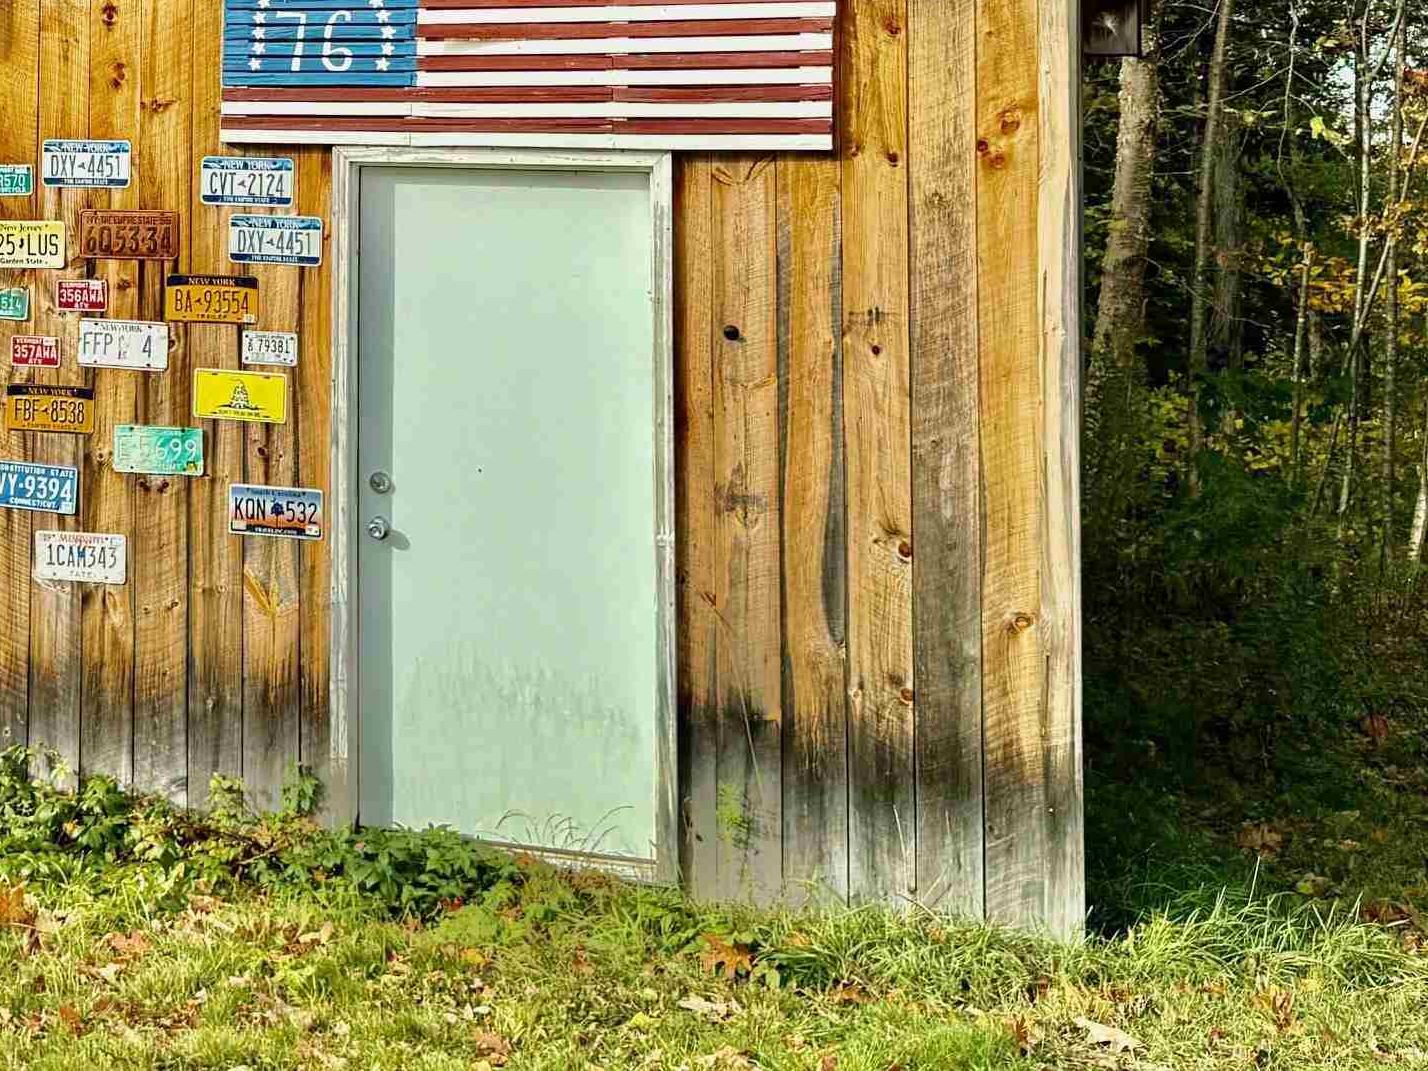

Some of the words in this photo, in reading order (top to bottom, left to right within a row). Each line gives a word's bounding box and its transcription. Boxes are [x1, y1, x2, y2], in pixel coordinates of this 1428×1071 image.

[275, 10, 353, 72] 76
[87, 154, 121, 178] 4451
[223, 160, 244, 170] NEW
[247, 160, 270, 170] YORK
[209, 171, 237, 195] CVT
[247, 172, 284, 197] 2124
[26, 233, 59, 256] LUS
[275, 230, 311, 255] 4451
[26, 258, 43, 266] State
[189, 277, 211, 286] NEW
[212, 277, 236, 286] YORK
[203, 289, 250, 314] 93554
[285, 500, 318, 525] 532
